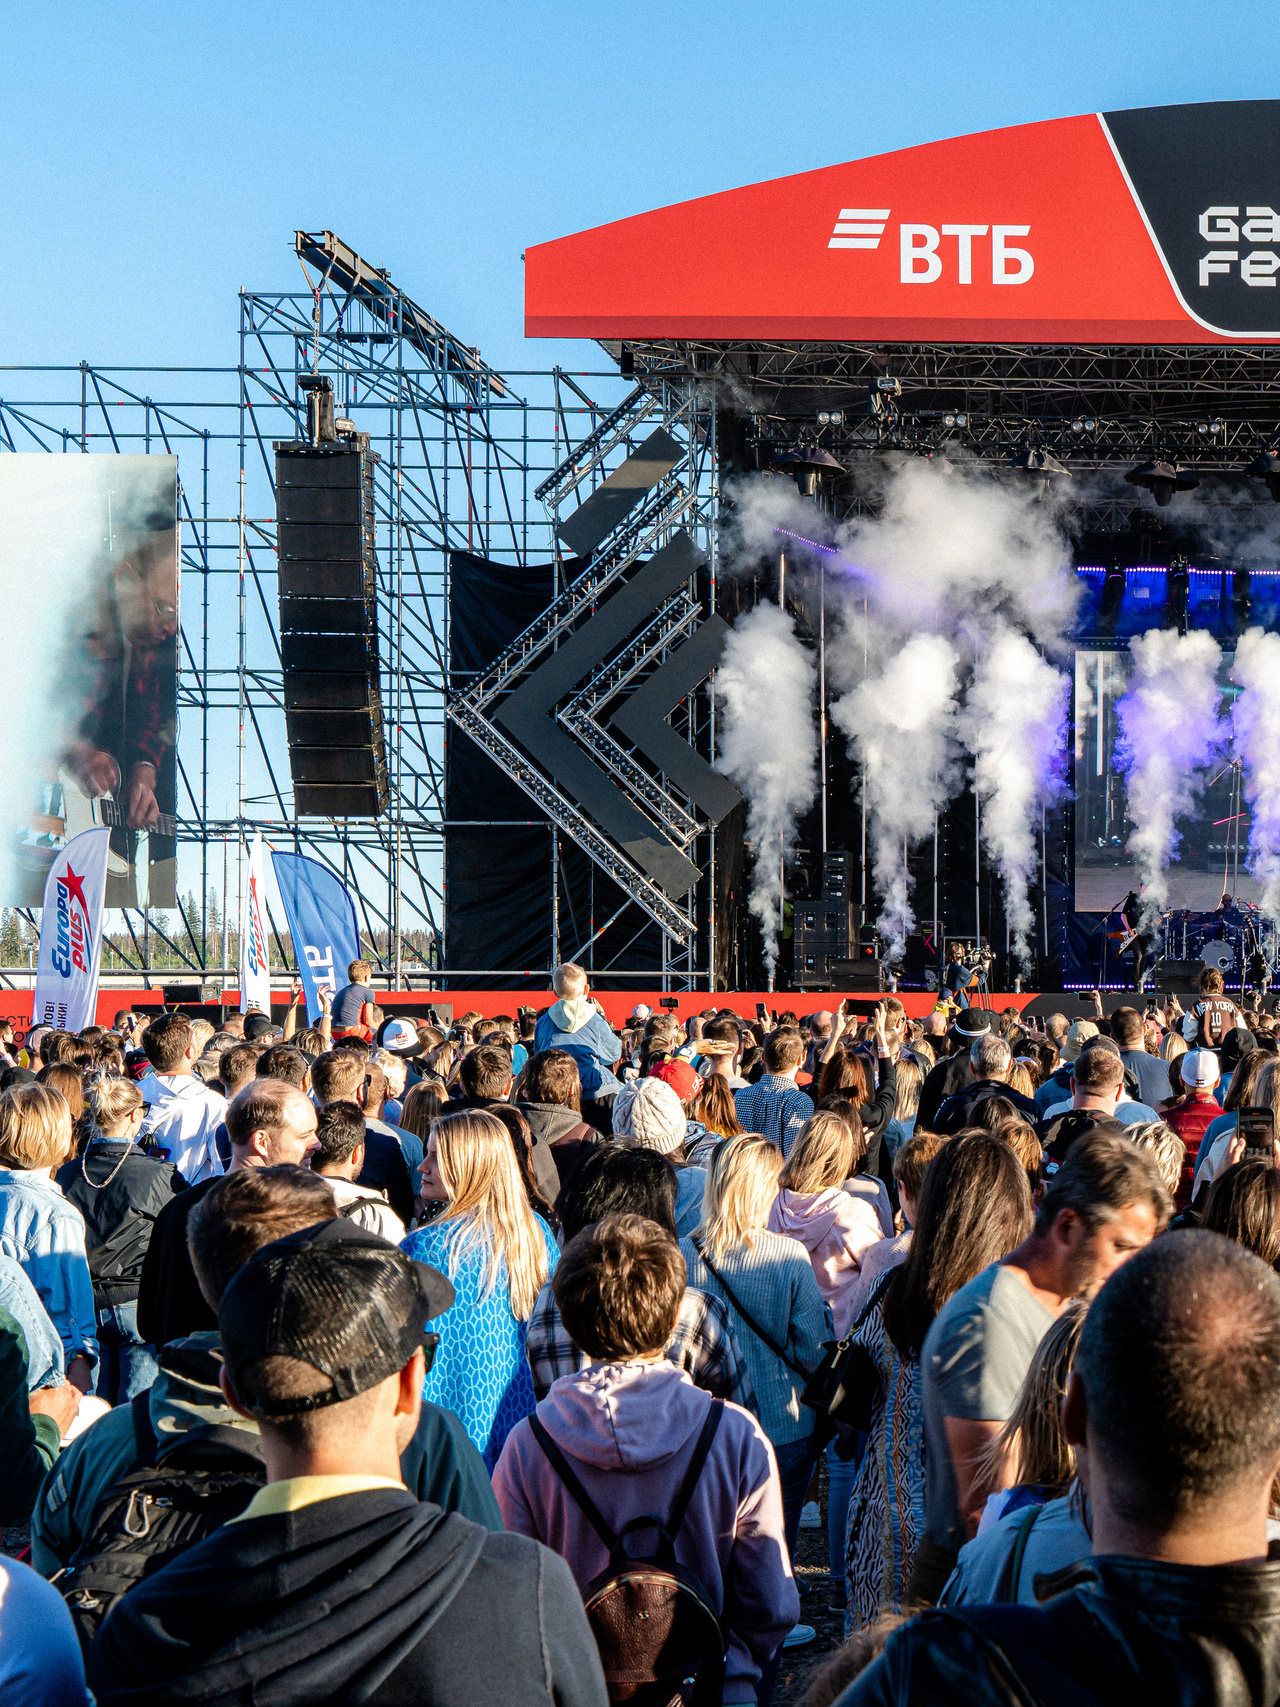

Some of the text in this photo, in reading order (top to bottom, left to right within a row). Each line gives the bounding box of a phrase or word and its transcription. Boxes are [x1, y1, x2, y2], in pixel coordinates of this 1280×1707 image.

[899, 223, 1035, 285] ВТБ
[51, 882, 71, 979] Europa
[69, 908, 88, 974] plus
[43, 1001, 55, 1025] ТОВ!
[56, 1003, 68, 1031] ЫКИ!
[1211, 1011, 1222, 1027] 10
